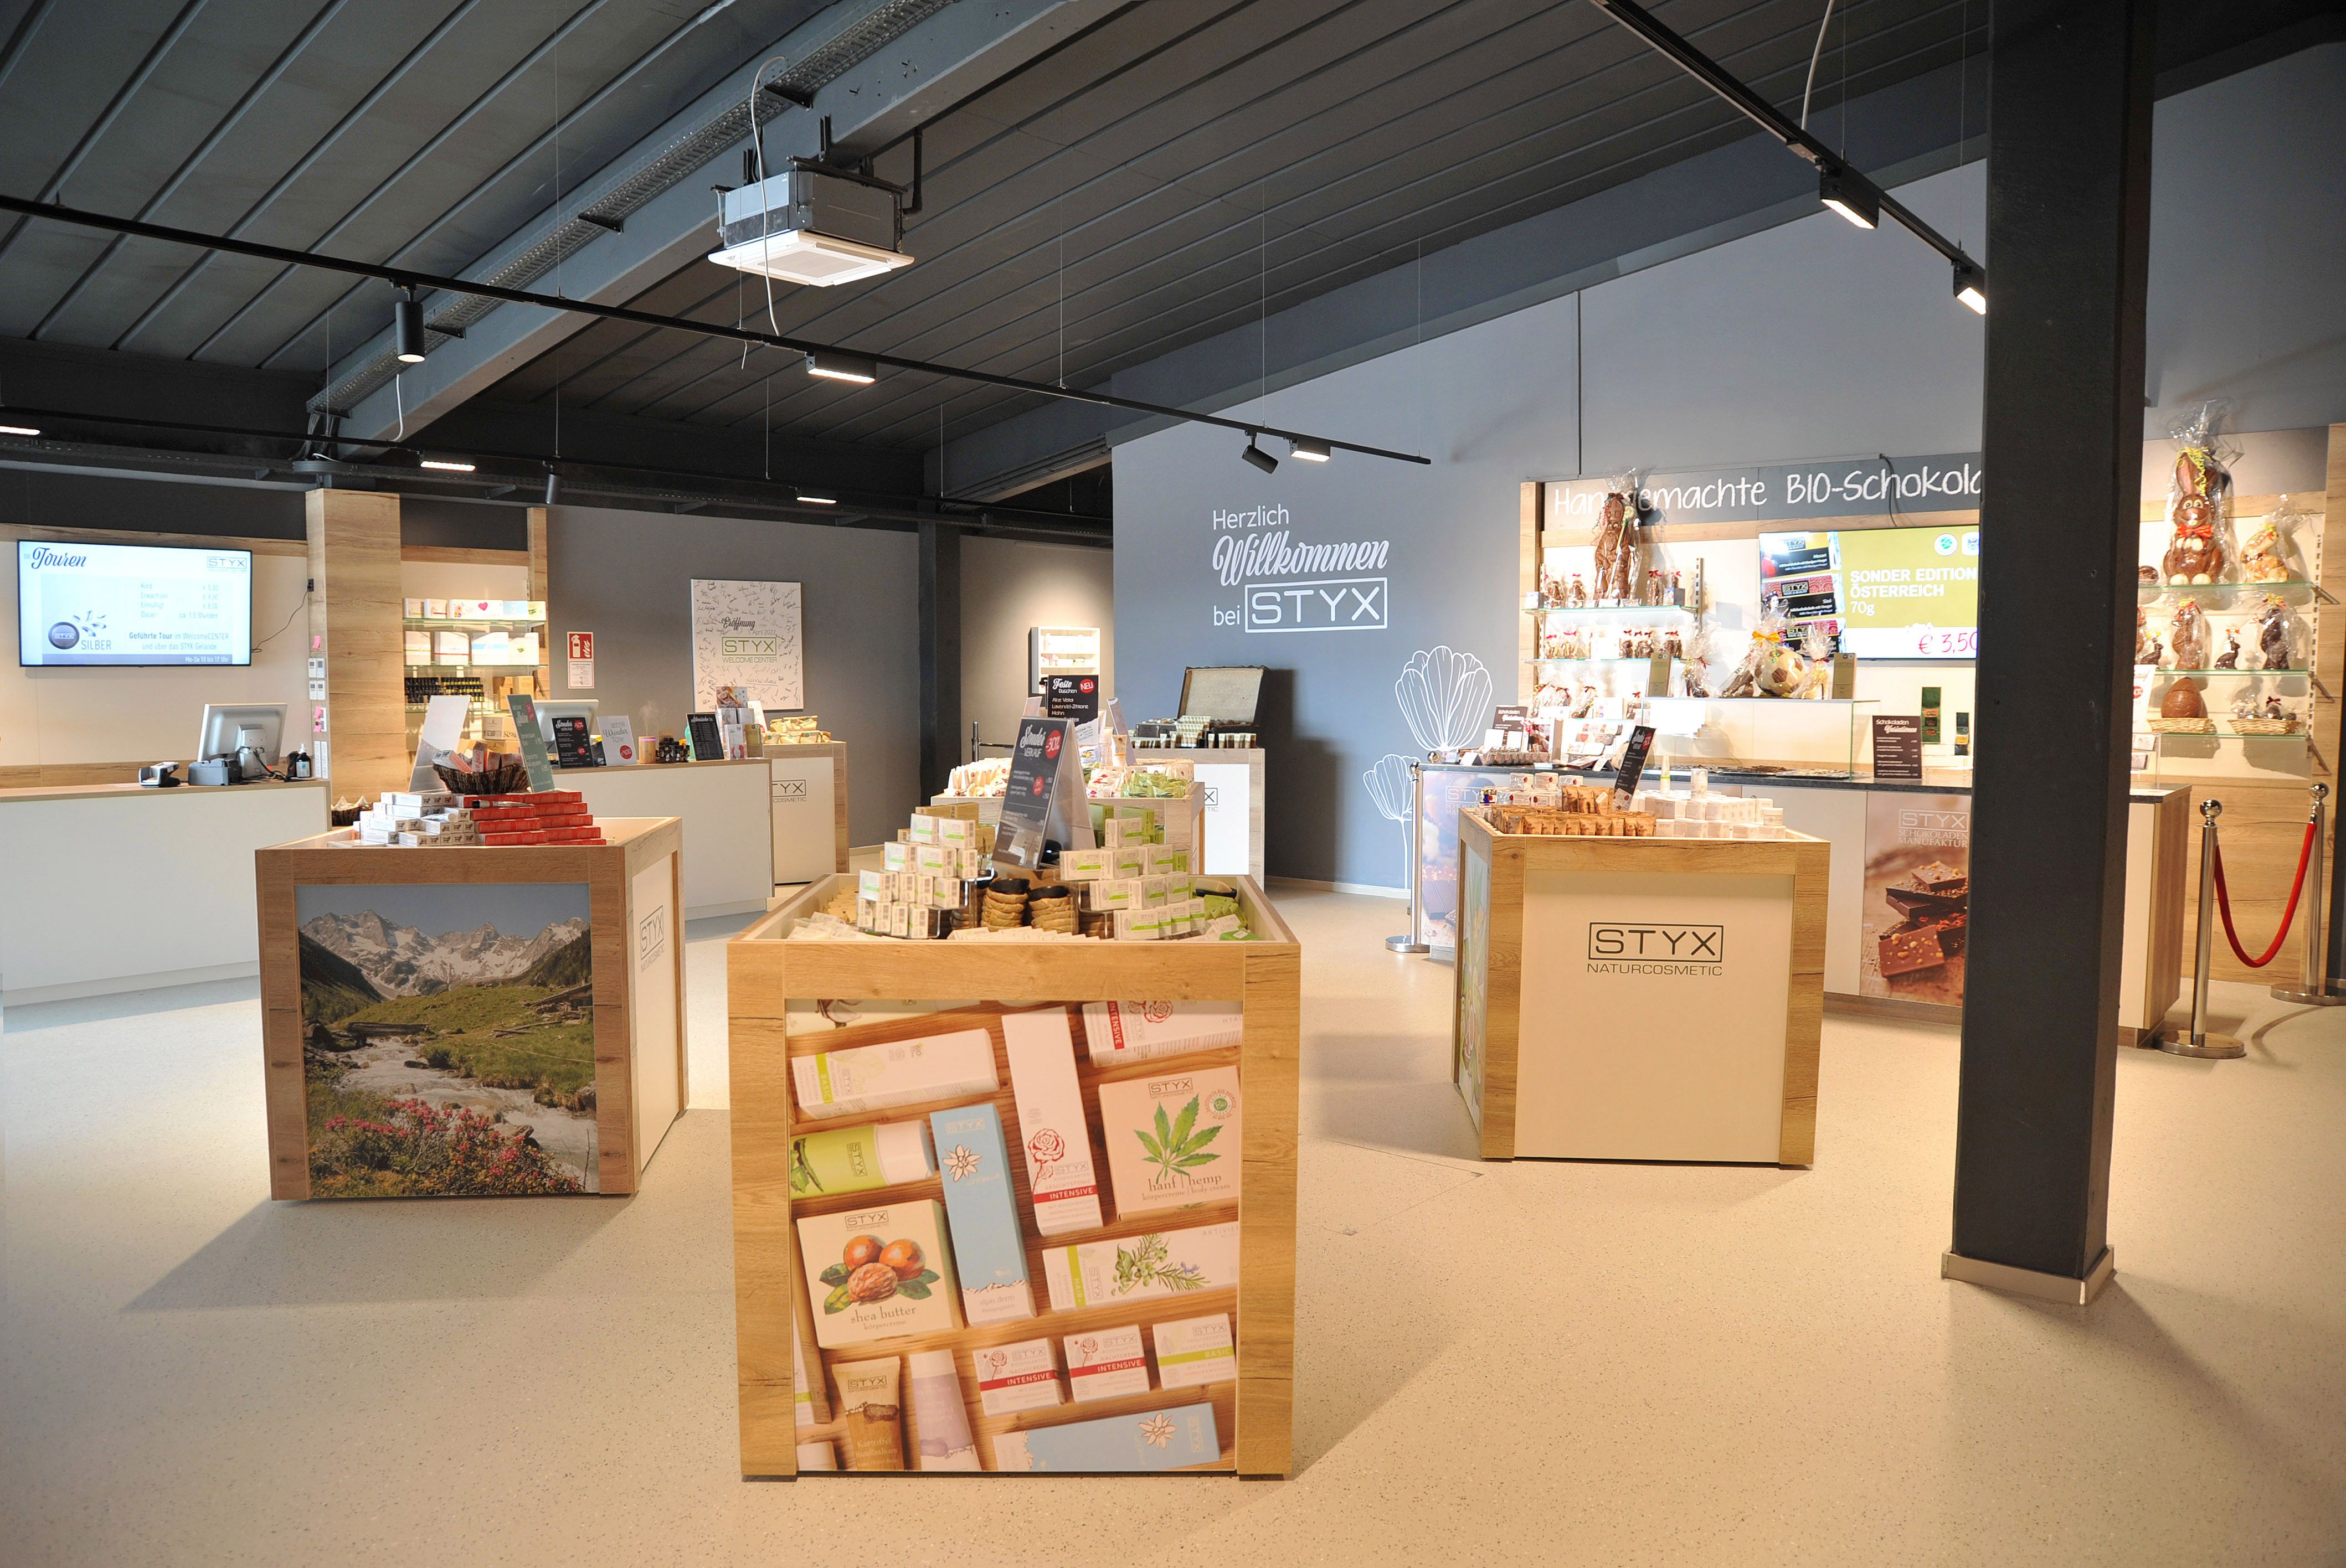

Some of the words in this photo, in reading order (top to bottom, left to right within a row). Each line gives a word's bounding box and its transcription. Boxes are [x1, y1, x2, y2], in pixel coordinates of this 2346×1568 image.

[1555, 477, 1767, 515] Hanemachte
[1213, 503, 1289, 530] Herzlich
[31, 546, 86, 569] Touren
[208, 558, 245, 567] STYX
[1212, 530, 1390, 586] Willkommen
[1850, 569, 1911, 582] SONDER
[1915, 567, 1978, 581] EDITION
[1850, 582, 1944, 599] ÖSTERREICH
[1213, 605, 1240, 626] bei
[1251, 586, 1380, 624] STYX
[1850, 601, 1875, 616] 70g
[721, 616, 755, 631] Eröffnung
[81, 639, 111, 650] SILBER
[724, 639, 774, 653] STYX
[1918, 635, 1933, 654] €
[1052, 678, 1072, 690] Feste
[1079, 682, 1094, 691] NEU
[1020, 724, 1046, 748] Sonder
[1046, 735, 1061, 752] -30%
[1448, 788, 1479, 801] STY
[1902, 813, 1966, 829] STYX
[1897, 829, 1968, 840] SCHOKOLADEN
[1898, 837, 1968, 848] MANUFAKTUR
[641, 912, 663, 952] STYX
[1595, 929, 1717, 956] STYX
[1587, 963, 1722, 976] NATURCOSMETIC
[1109, 1002, 1123, 1045] INTENSIVE
[820, 1074, 830, 1098] BASIC
[1151, 1080, 1191, 1094] STYX
[946, 1118, 985, 1132] STYX
[852, 1143, 865, 1175] STYX
[1056, 1162, 1087, 1173] STYX
[1148, 1175, 1176, 1191] hanf
[1188, 1173, 1222, 1186] hemp
[1049, 1187, 1093, 1200] INTENSIVE
[1142, 1191, 1186, 1201] körpercreme
[1191, 1185, 1208, 1194] body
[847, 1211, 887, 1226] STYX
[1090, 1267, 1101, 1298] STYX
[851, 1309, 877, 1323] shea
[880, 1306, 917, 1319] butter
[1194, 1324, 1225, 1334] STYX
[1105, 1335, 1135, 1346] STYX
[1013, 1348, 1045, 1358] STYX
[1205, 1348, 1232, 1358] BASIC
[1097, 1359, 1141, 1373] INTENSIVE
[850, 1377, 885, 1388] STYX
[1007, 1373, 1051, 1385] INTENSIVE
[858, 1438, 892, 1447] Kartoffel
